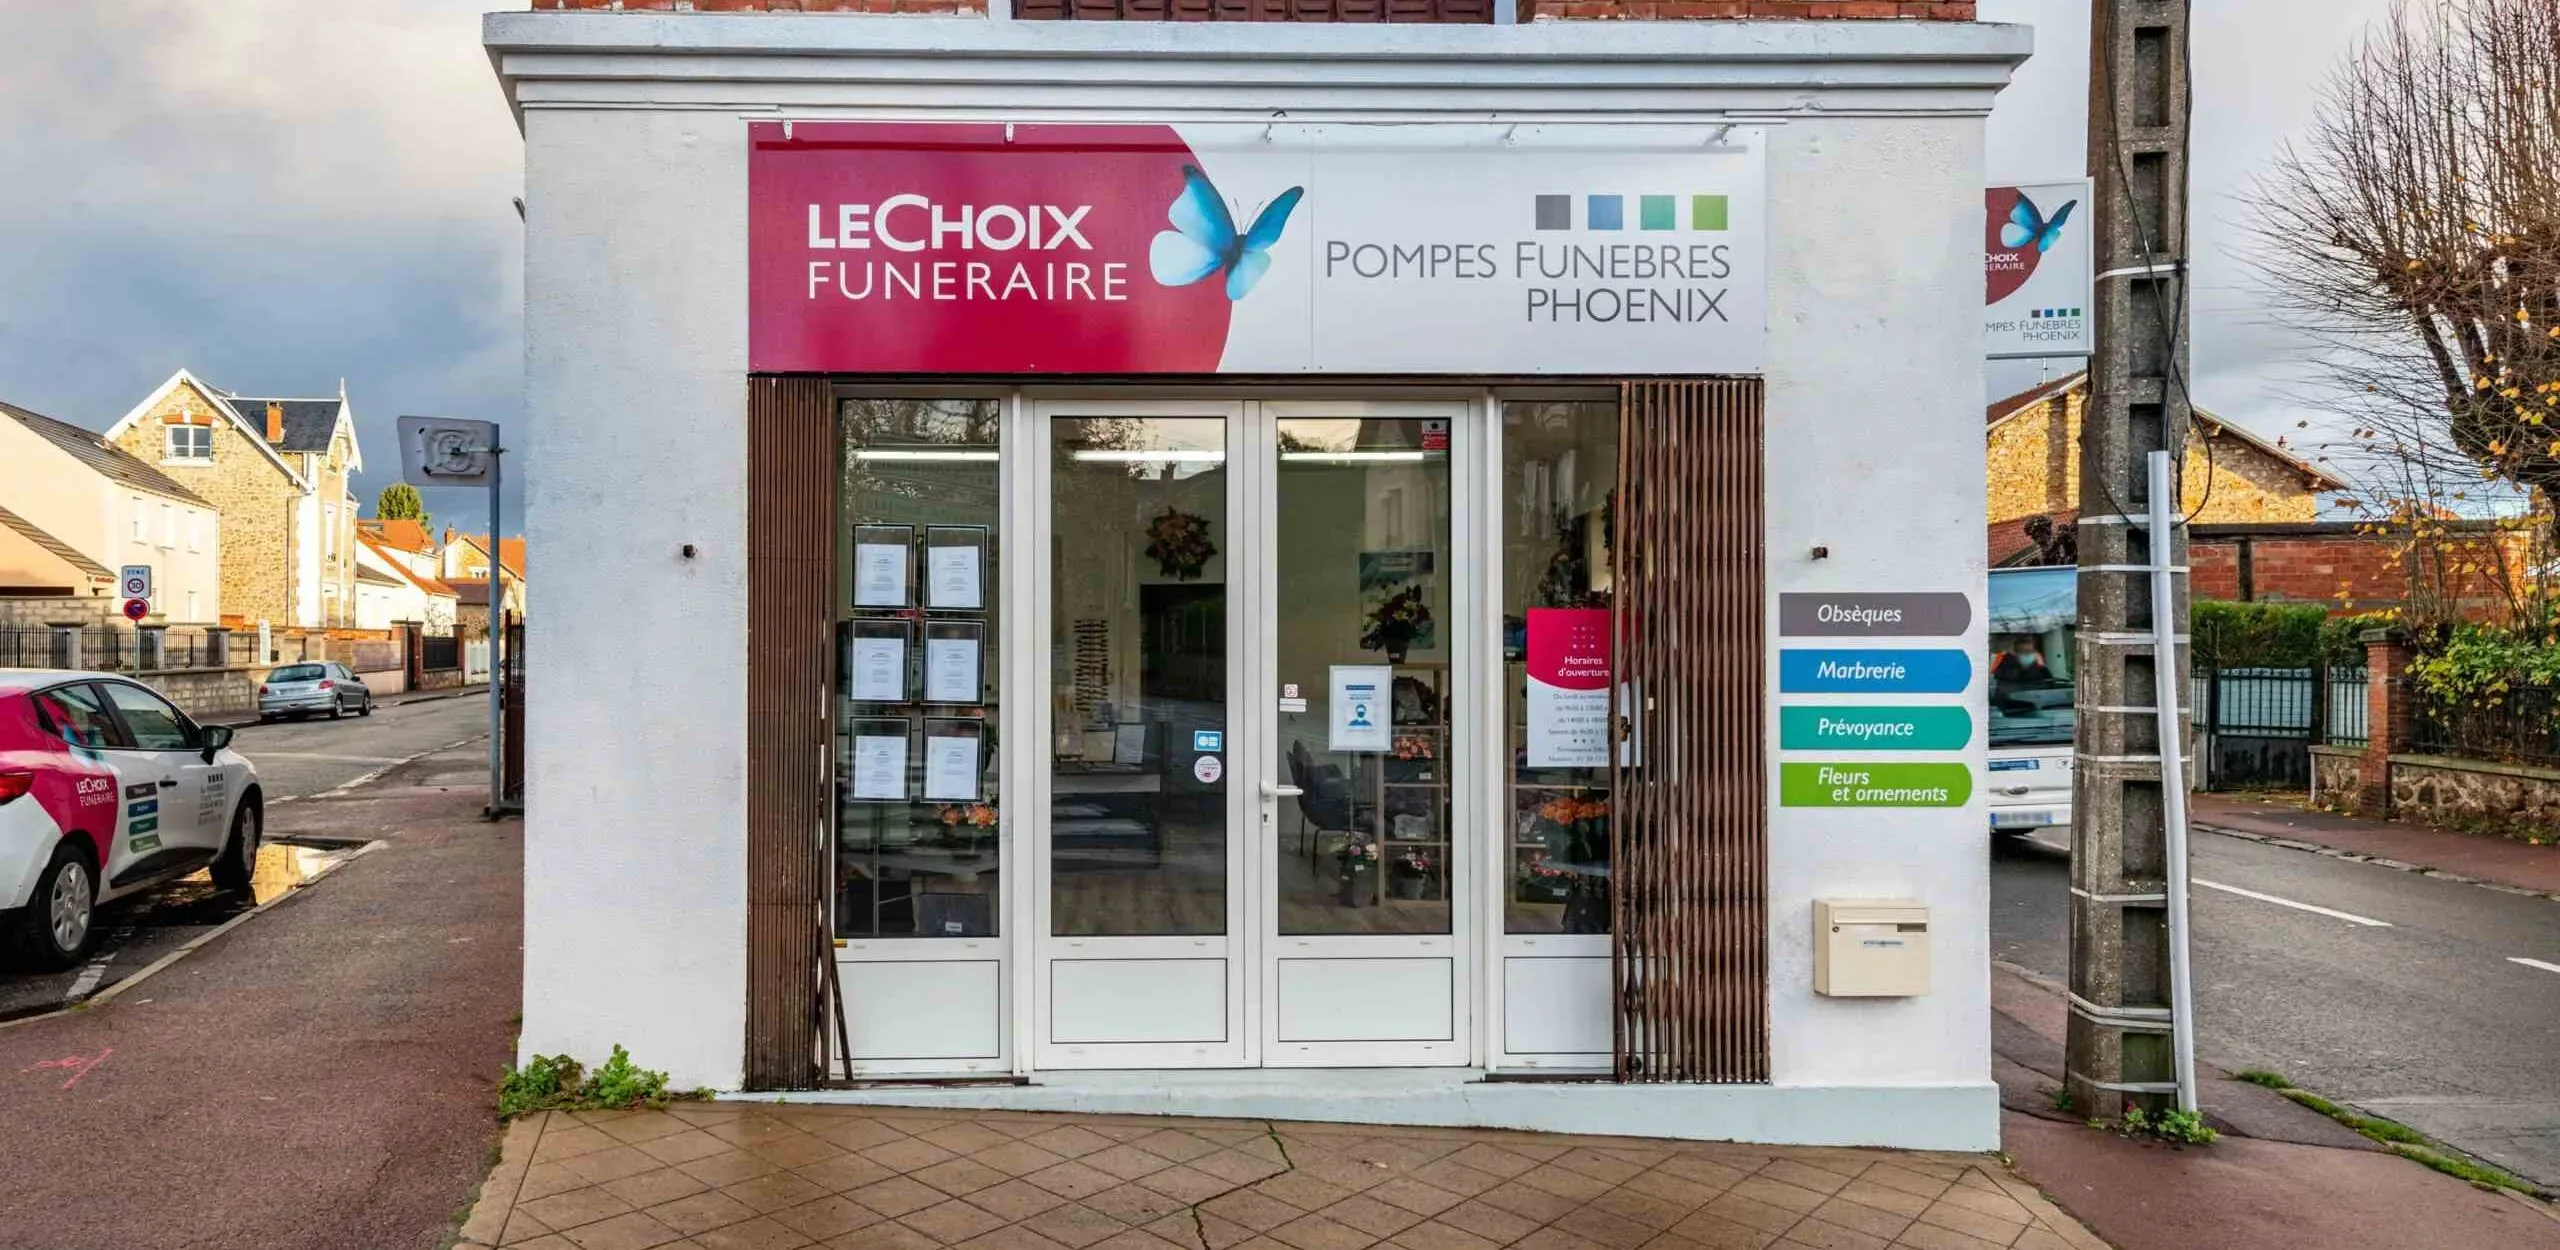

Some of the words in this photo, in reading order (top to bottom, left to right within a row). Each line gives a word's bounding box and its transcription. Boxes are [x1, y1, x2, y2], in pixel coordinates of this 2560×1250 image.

[808, 193, 1093, 252] LECHOIX
[1326, 240, 1497, 279] POMPES
[1516, 240, 1731, 280] FUNEBRES
[808, 261, 1128, 301] FUNERAIRE
[1527, 288, 1729, 323] PHOENIX
[1985, 321, 2016, 333] MPES
[2019, 319, 2081, 331] FUNEBRES
[2023, 331, 2080, 341] PHOENIX
[1818, 604, 1902, 627] Obsèques
[1564, 655, 1603, 665] Horaires
[1558, 667, 1609, 677] d'ouverture
[1817, 661, 1906, 679] Marbrerie
[1817, 718, 1915, 741] Prévoyance
[1818, 767, 1870, 785] Fleurs
[1832, 787, 1851, 802] et
[1855, 787, 1949, 802] ornements
